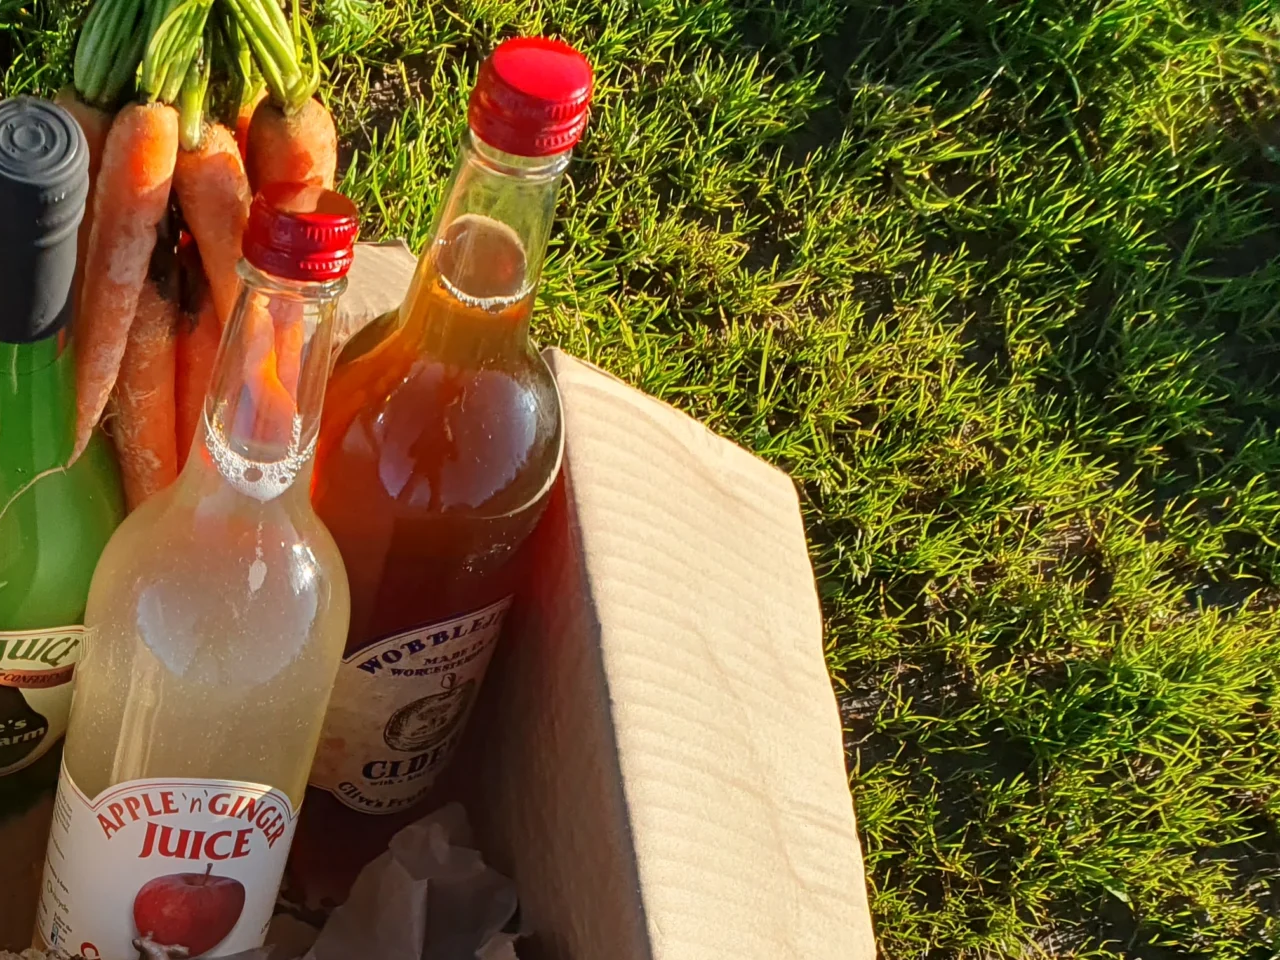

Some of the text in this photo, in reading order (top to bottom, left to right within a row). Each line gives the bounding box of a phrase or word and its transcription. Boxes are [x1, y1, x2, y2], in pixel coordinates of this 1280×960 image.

[97, 791, 179, 840] APPLE
[208, 793, 286, 849] GINGER
[138, 821, 254, 860] JUICE
